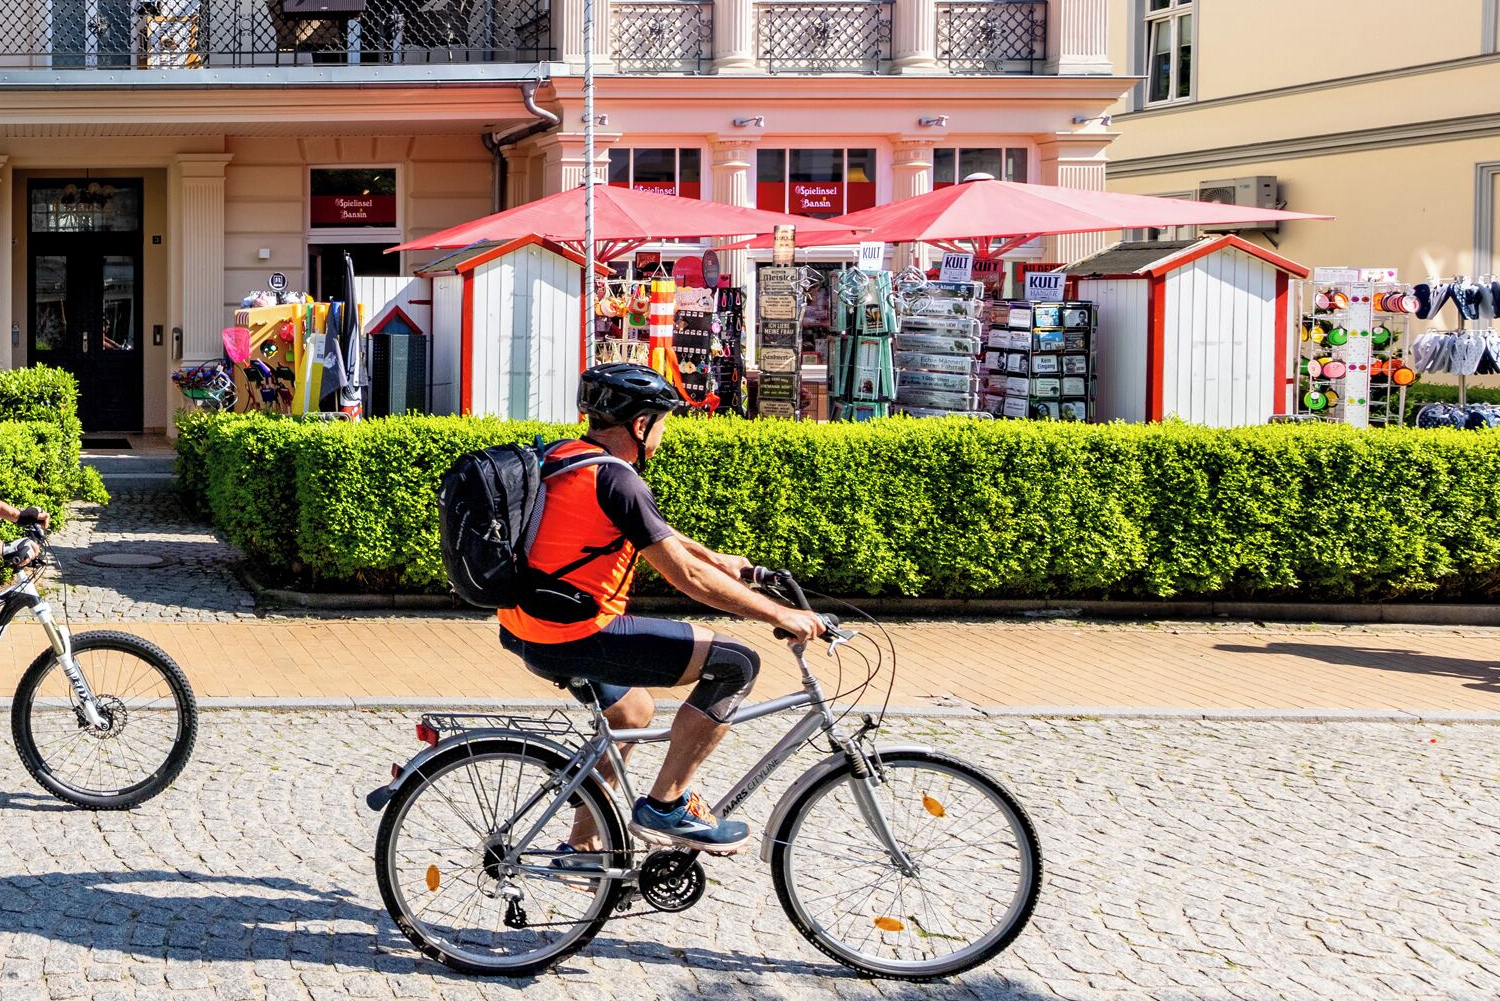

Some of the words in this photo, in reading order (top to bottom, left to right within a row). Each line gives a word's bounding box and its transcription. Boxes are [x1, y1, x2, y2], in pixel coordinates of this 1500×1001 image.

[800, 186, 837, 196] Spielinsel
[340, 199, 372, 208] Spielinsel
[804, 199, 831, 207] Bansin
[344, 210, 367, 218] Bansin
[862, 247, 881, 259] KULT
[945, 256, 970, 270] KULT
[1029, 276, 1060, 289] KULT
[722, 788, 749, 818] MARS
[747, 758, 780, 791] CITYLINE
